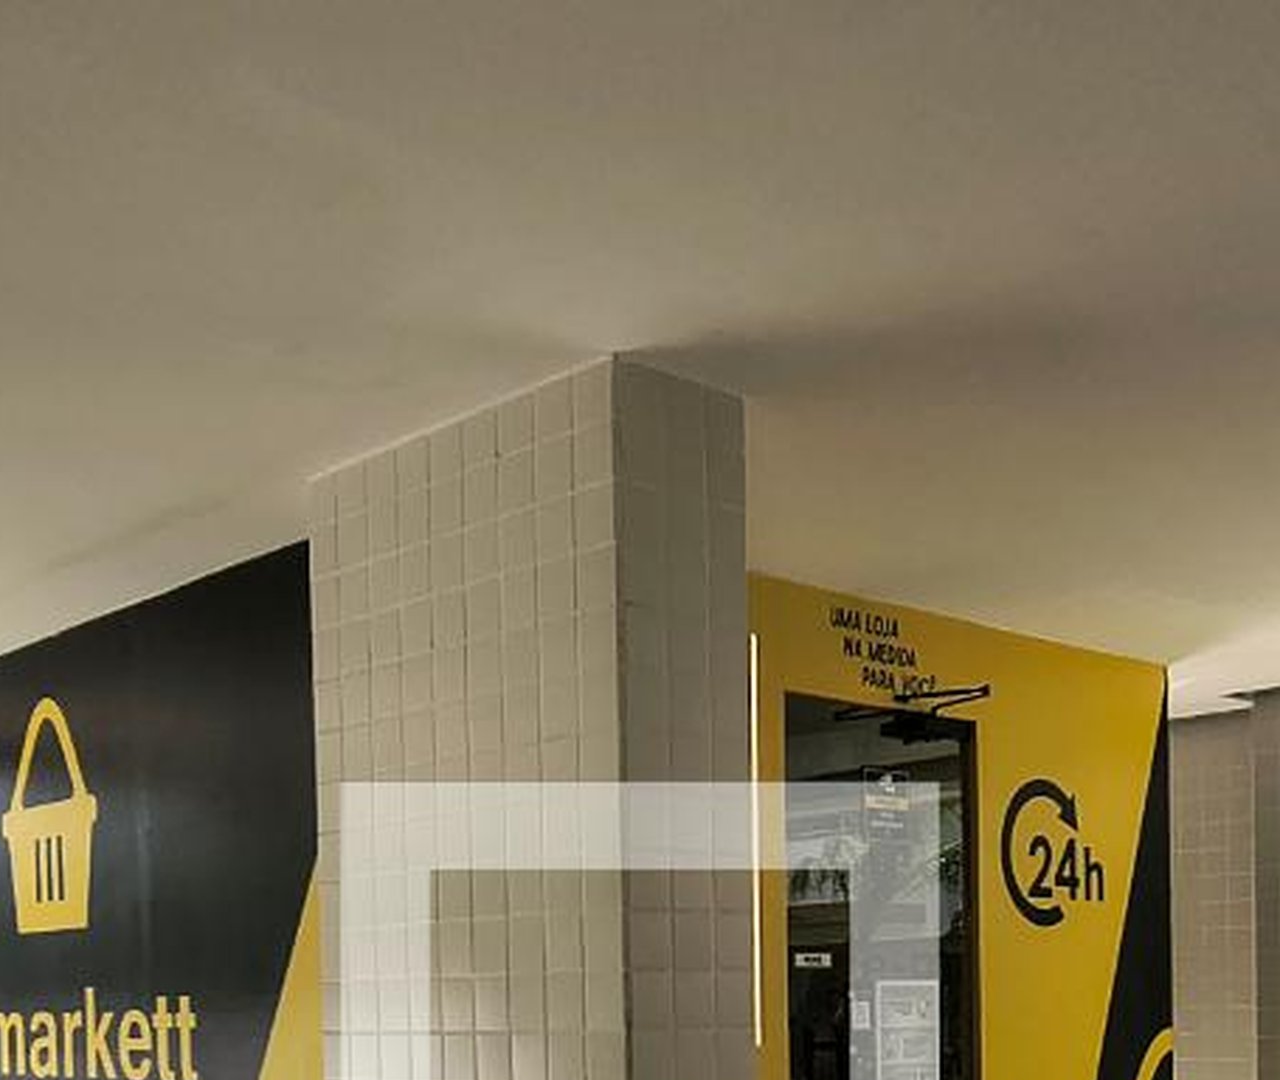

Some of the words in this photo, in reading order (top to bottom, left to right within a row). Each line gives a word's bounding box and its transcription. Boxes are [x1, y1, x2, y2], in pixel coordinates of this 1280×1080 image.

[829, 607, 861, 631] UMA
[865, 612, 898, 638] LOJA
[843, 635, 862, 658] NA
[868, 640, 917, 668] MEDIDA
[862, 665, 895, 691] PARA
[1028, 834, 1104, 902] 24h
